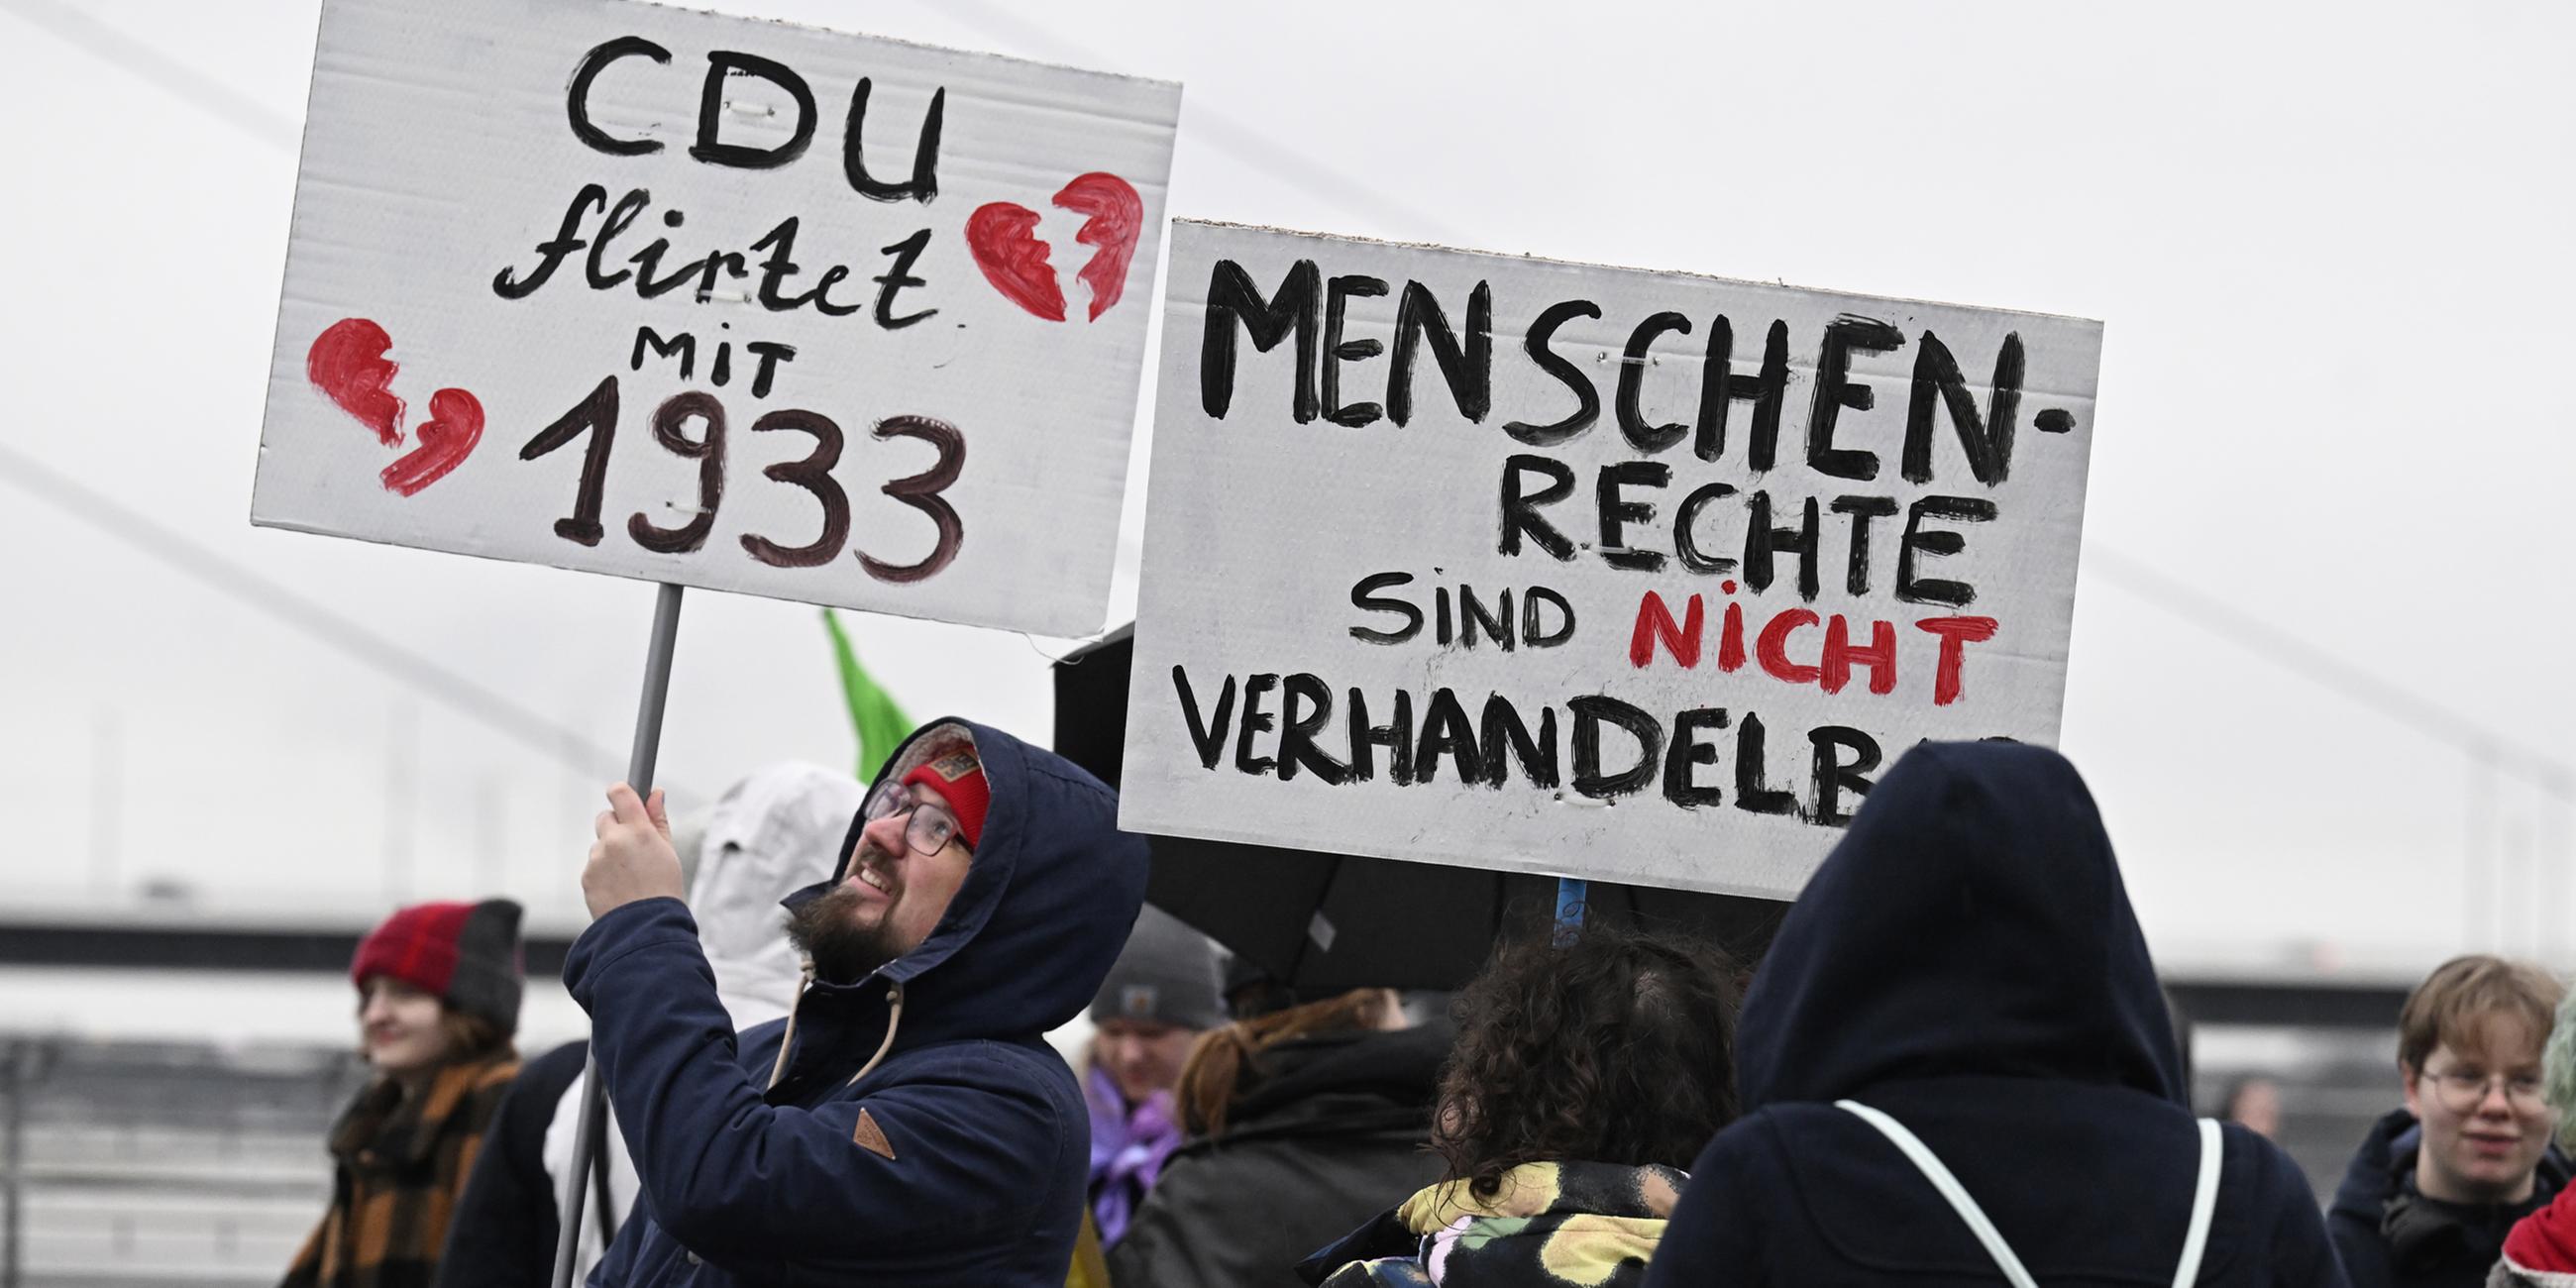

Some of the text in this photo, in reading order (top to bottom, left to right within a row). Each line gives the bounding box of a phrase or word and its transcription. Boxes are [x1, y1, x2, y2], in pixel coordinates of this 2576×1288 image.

[568, 36, 944, 204] CDU
[493, 183, 938, 330] flirtet
[1200, 259, 2077, 487] MENSCHEN-
[519, 375, 966, 585] 1933
[1498, 453, 1999, 608] RECHTE
